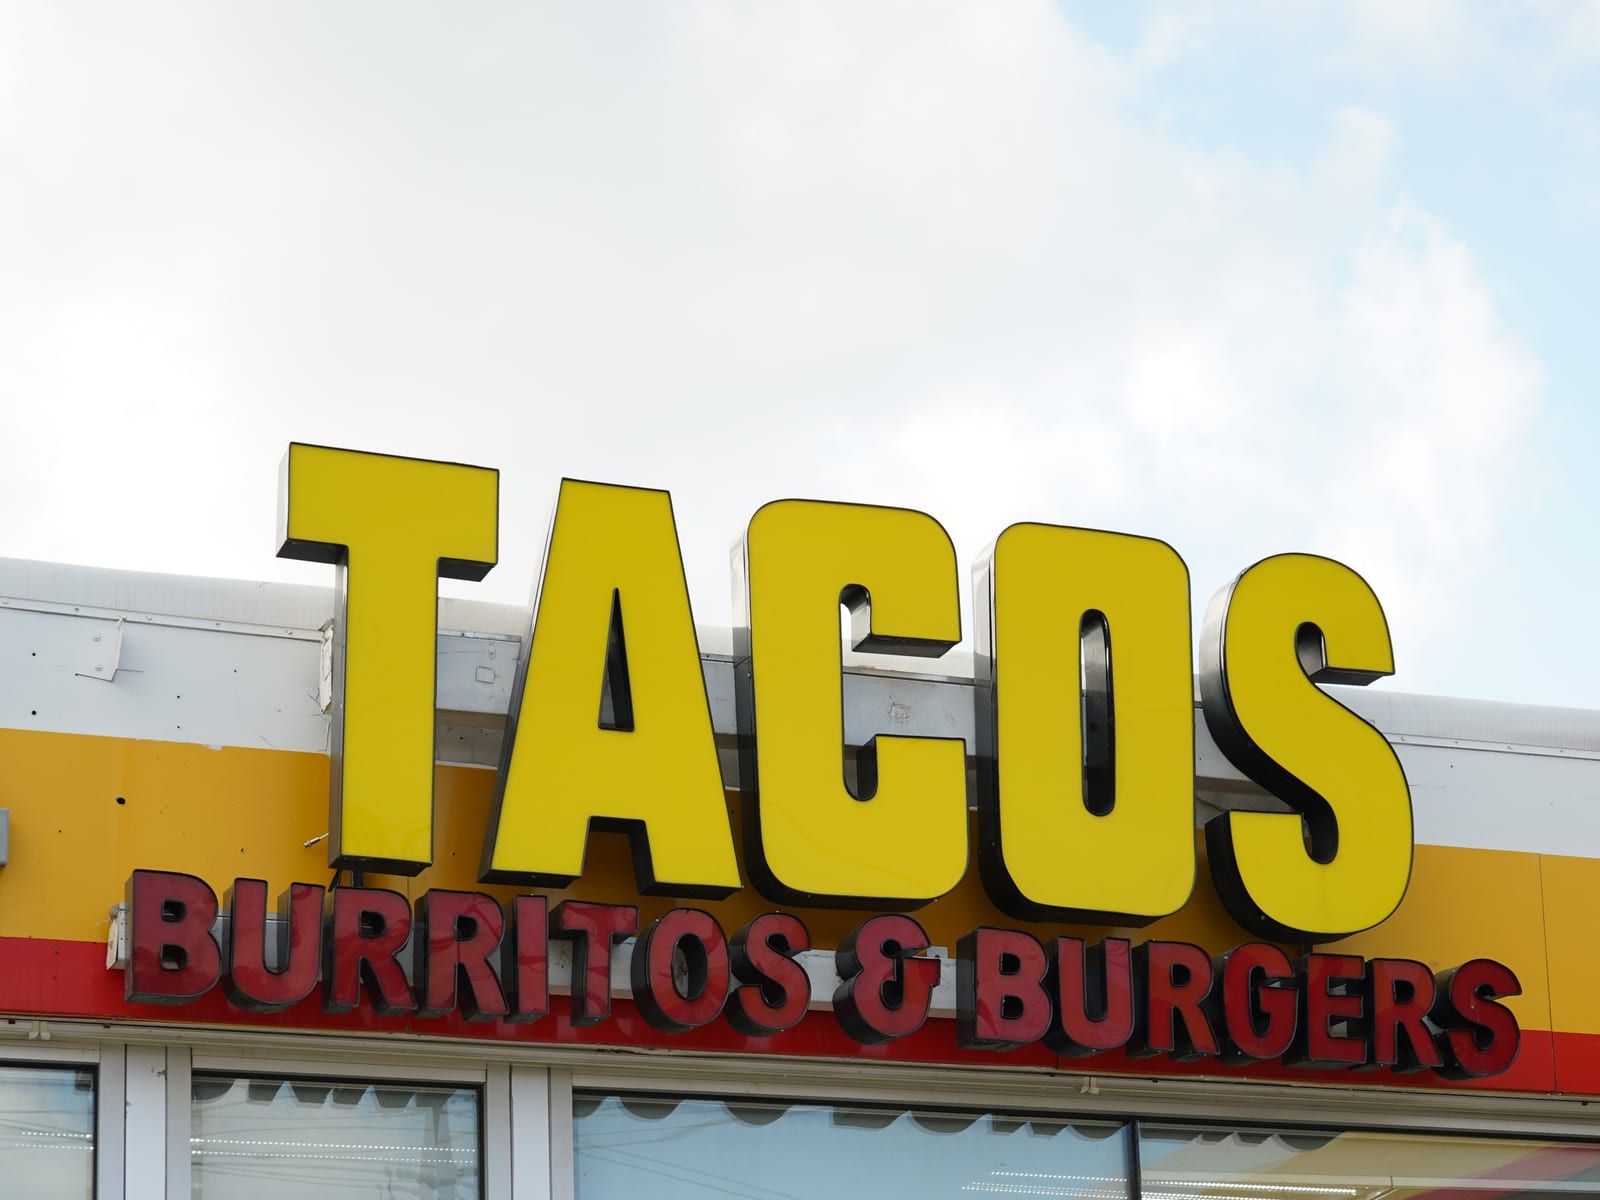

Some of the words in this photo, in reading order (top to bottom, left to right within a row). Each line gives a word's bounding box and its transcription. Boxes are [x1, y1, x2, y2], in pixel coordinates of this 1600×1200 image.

[278, 442, 1413, 942] TACOS
[125, 869, 812, 1036] BURRITOS
[833, 914, 942, 1044] &
[957, 926, 1523, 1079] BURGERS
